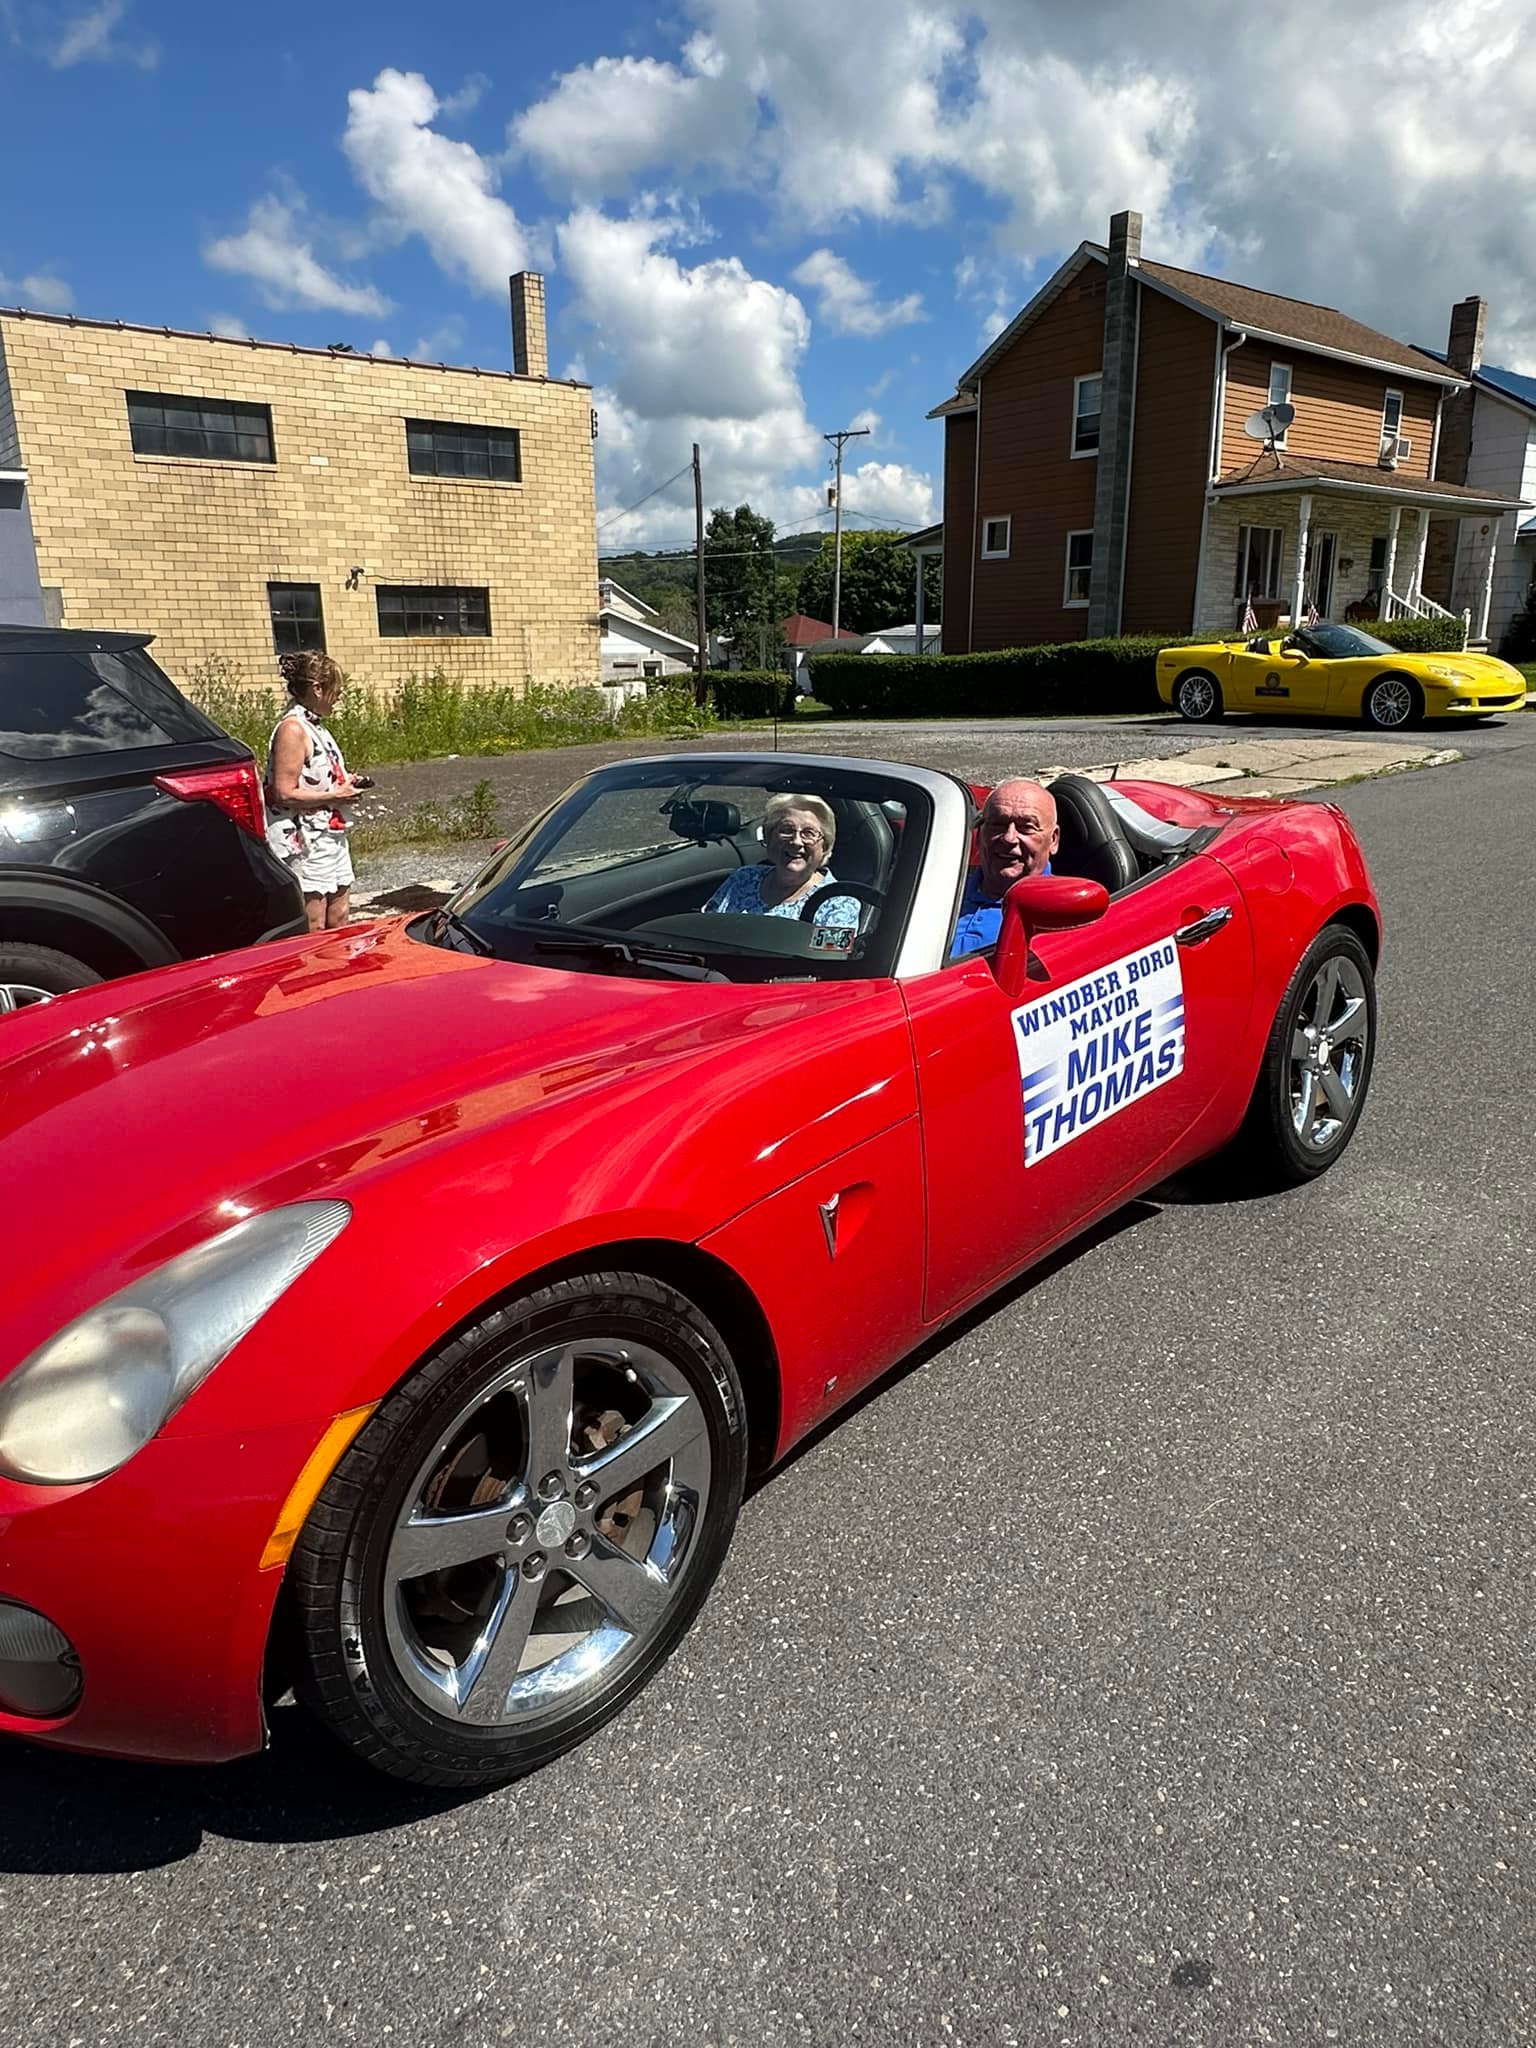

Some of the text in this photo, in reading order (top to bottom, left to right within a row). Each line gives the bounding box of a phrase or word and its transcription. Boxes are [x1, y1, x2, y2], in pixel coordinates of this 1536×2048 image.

[816, 929, 825, 946] 5
[1016, 945, 1175, 1037] WINDBER BORO
[1070, 988, 1140, 1040] MAYOR
[1067, 1009, 1152, 1091] MIKE
[1032, 1038, 1177, 1154] THOMAS
